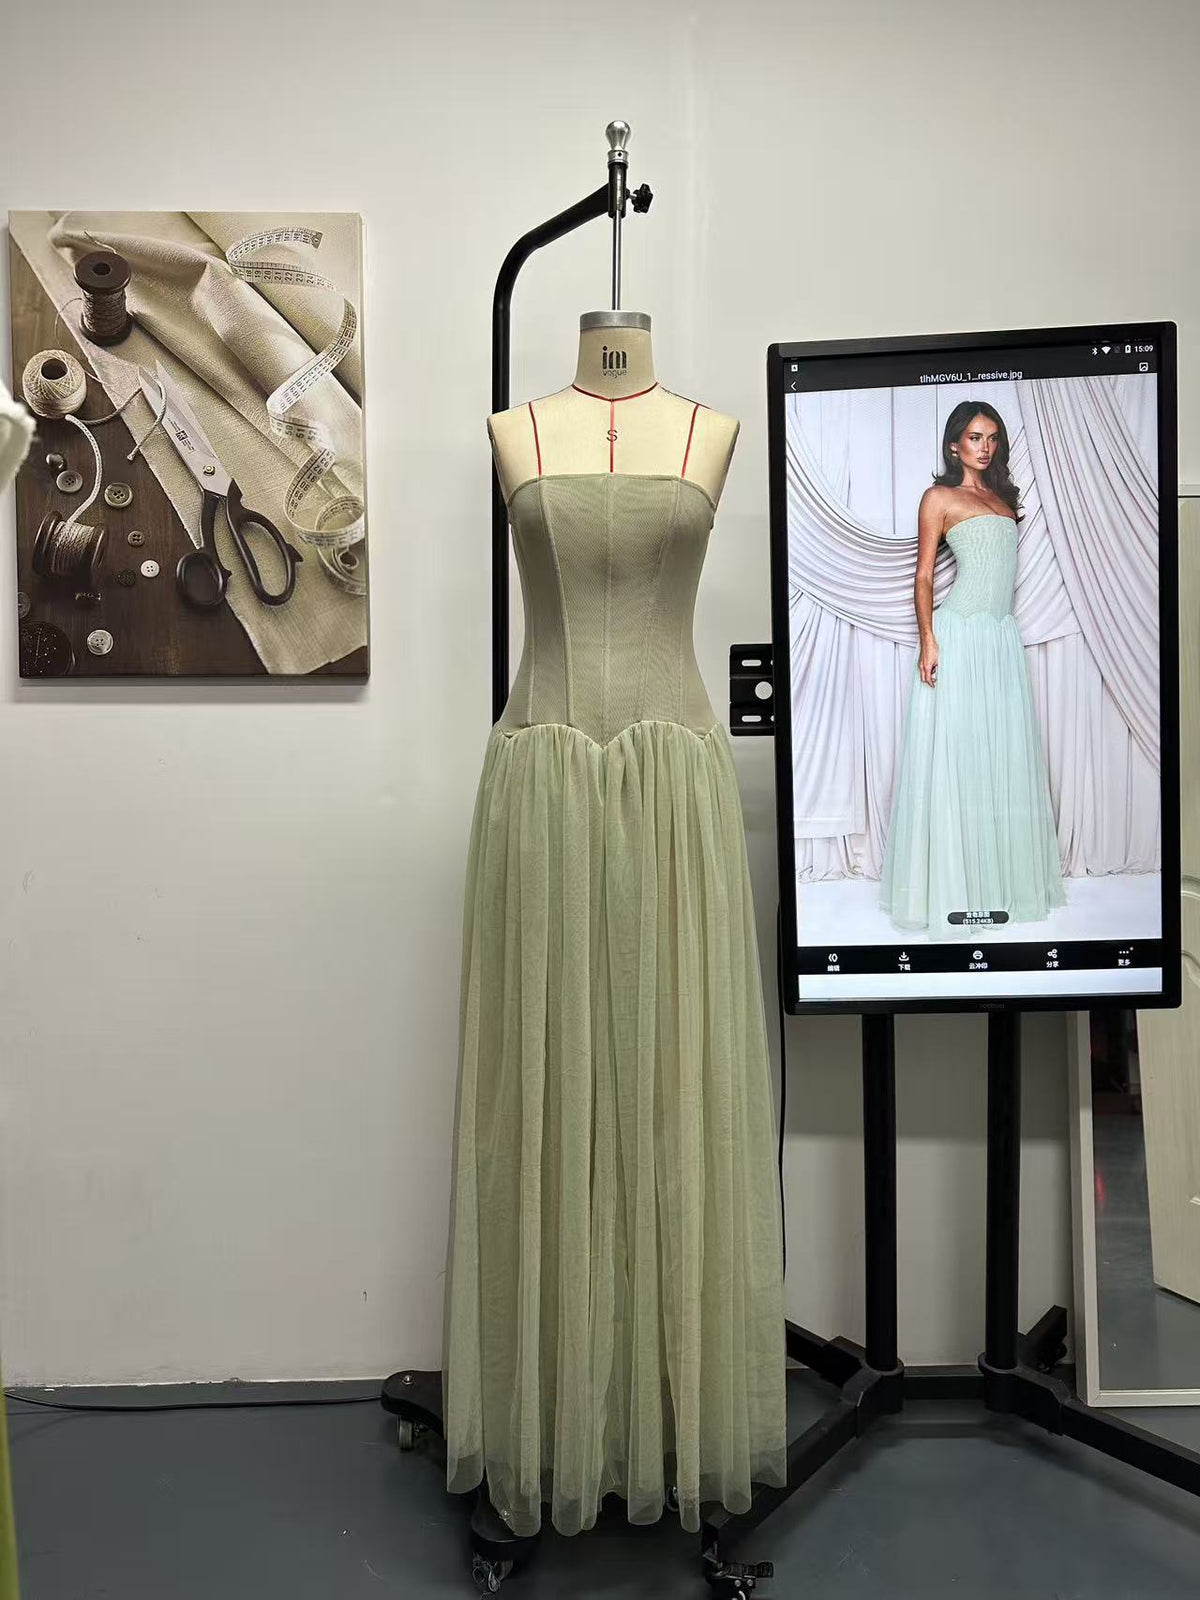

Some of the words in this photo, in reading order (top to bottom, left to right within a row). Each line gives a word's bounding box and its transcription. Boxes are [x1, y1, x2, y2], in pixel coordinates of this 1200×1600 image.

[264, 270, 271, 280] 20
[274, 272, 281, 281] 21
[285, 272, 293, 281] 22
[296, 274, 303, 283] 23
[306, 275, 314, 284] 24
[339, 340, 350, 348] 118
[334, 348, 345, 356] 117
[1134, 345, 1154, 353] 15:09
[602, 369, 627, 379] vogue
[606, 429, 618, 442] S
[1046, 960, 1059, 968] 分享
[1118, 958, 1131, 967] 更多
[898, 963, 911, 971] 下载
